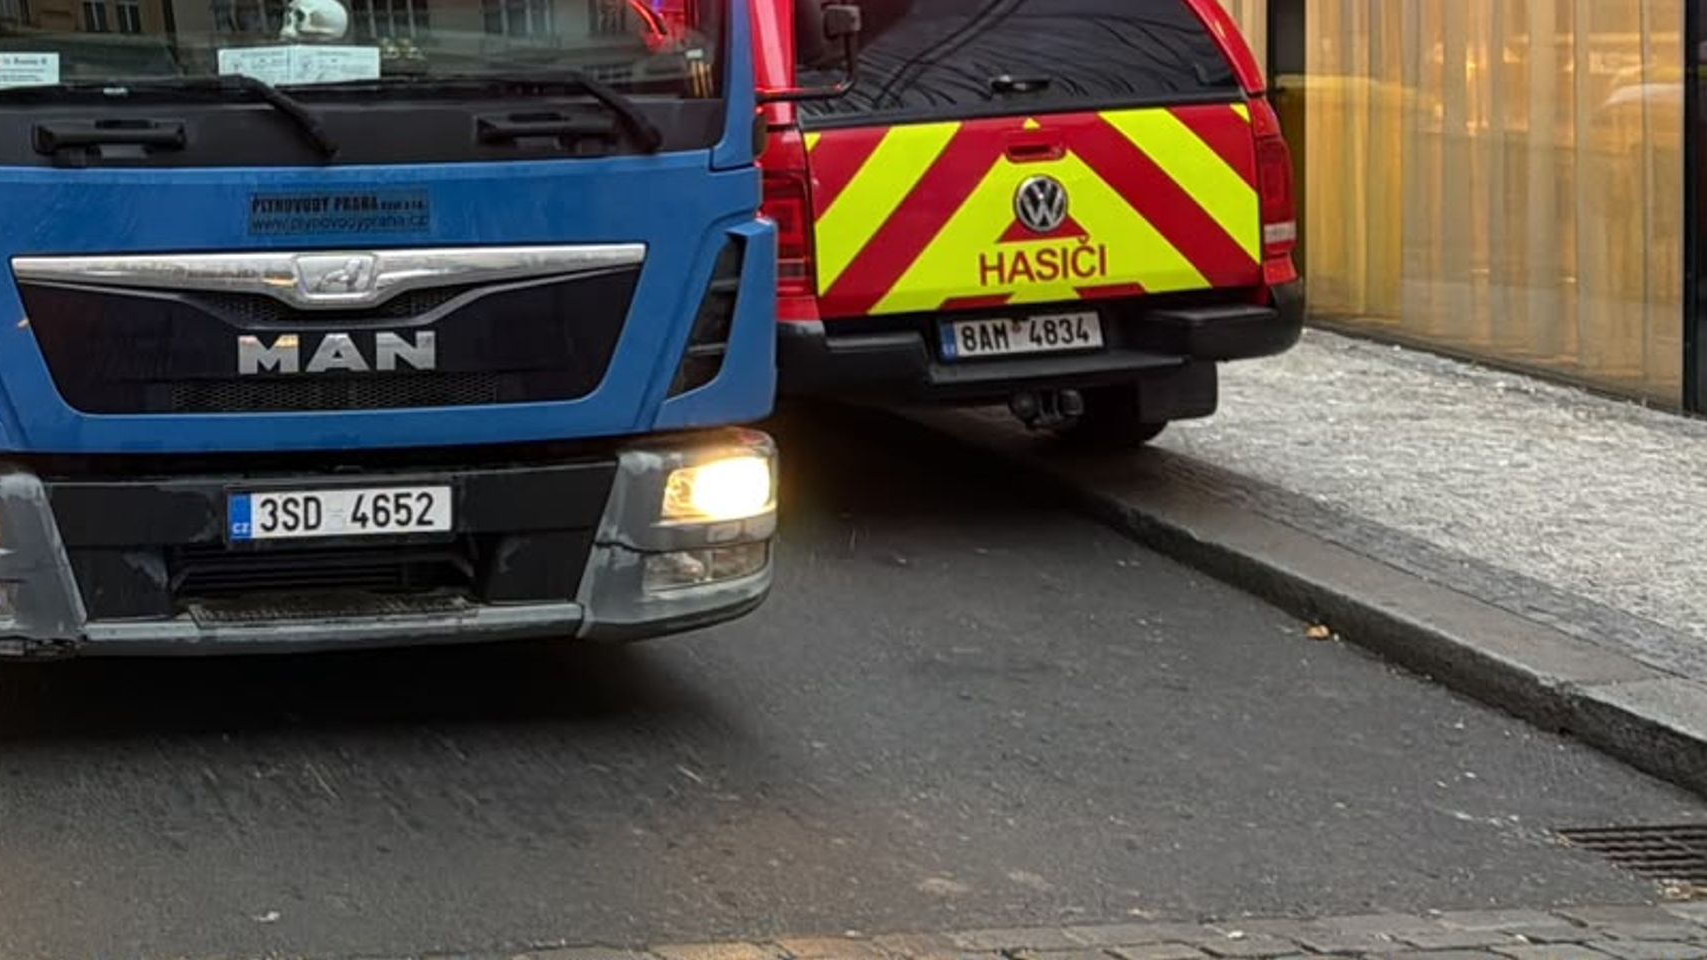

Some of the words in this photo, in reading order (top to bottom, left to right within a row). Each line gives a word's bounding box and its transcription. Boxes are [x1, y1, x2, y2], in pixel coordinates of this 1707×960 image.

[978, 234, 1107, 286] HASIČI
[237, 331, 436, 374] MAN
[961, 322, 1009, 352] 8AM
[1028, 316, 1090, 347] 4834
[259, 496, 322, 533] 3SD
[350, 492, 435, 528] 4652
